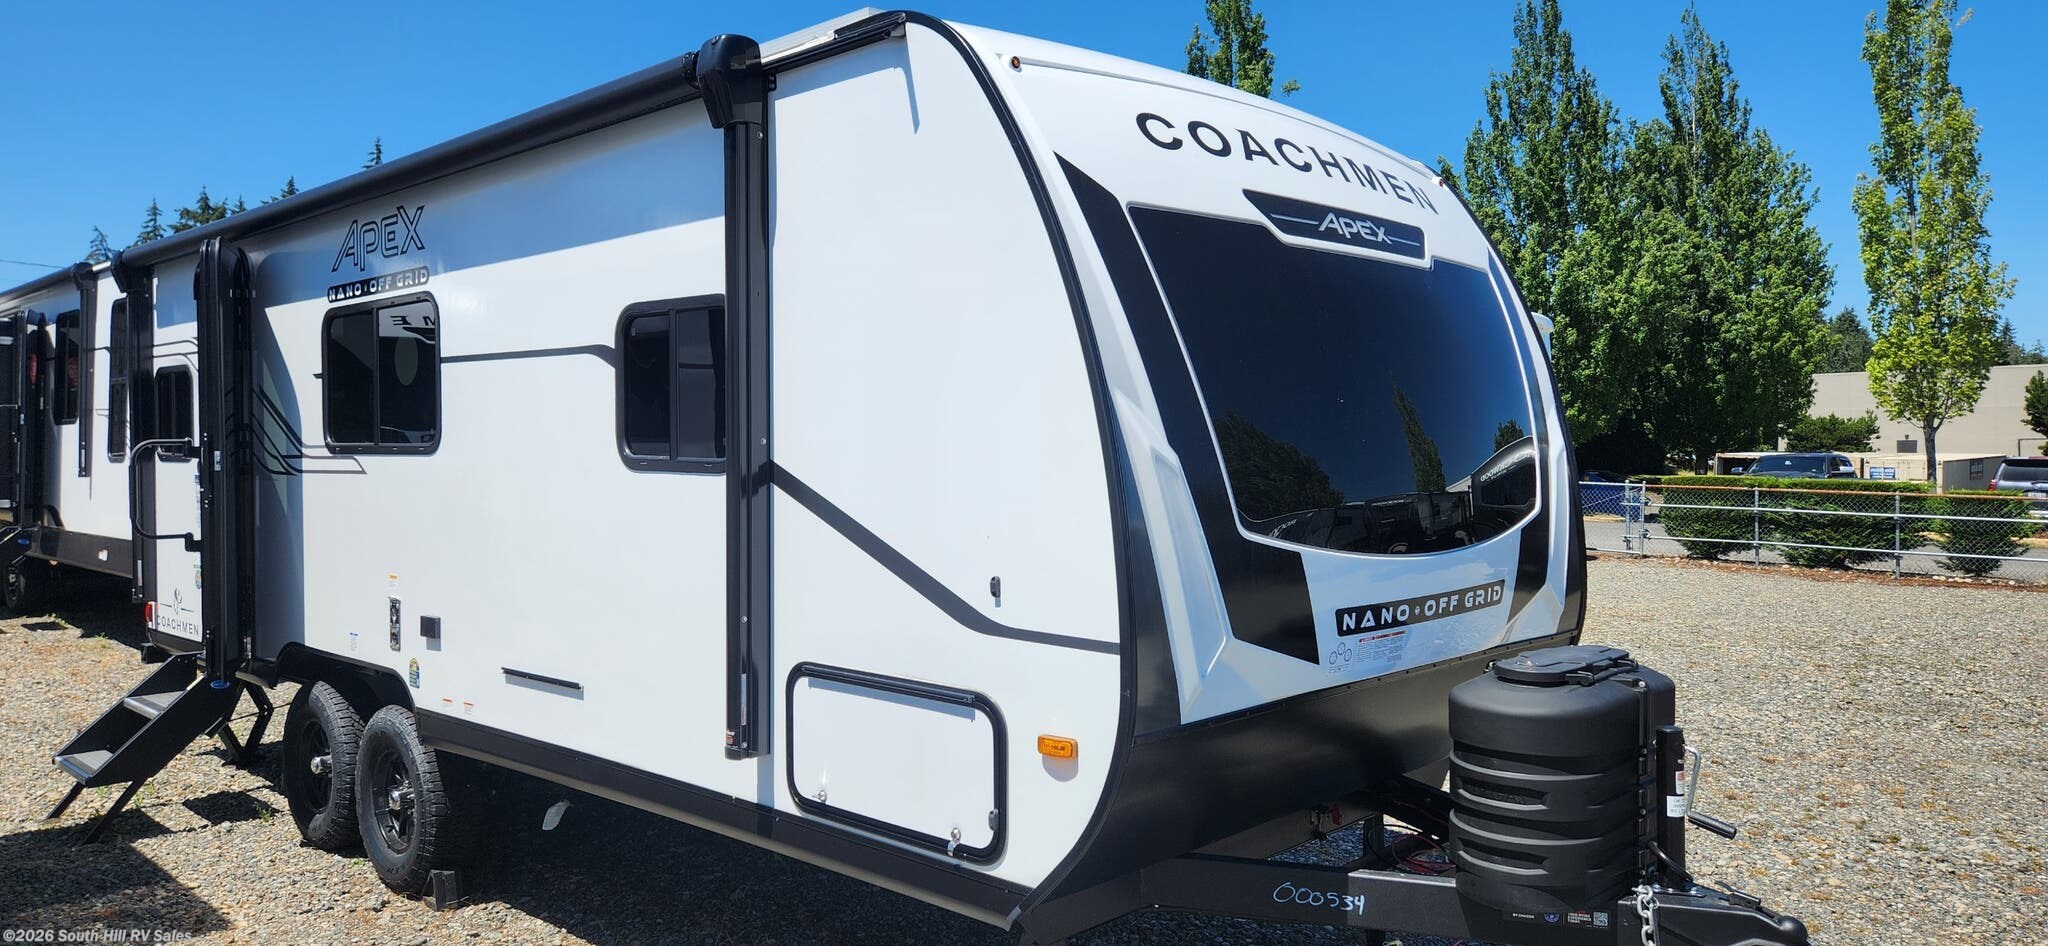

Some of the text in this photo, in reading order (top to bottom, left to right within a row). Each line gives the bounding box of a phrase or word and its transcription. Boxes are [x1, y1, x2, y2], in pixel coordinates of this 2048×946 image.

[1136, 112, 1439, 215] COACHMEN
[331, 205, 426, 272] APEX
[1318, 212, 1392, 244] APEX
[328, 269, 428, 301] NANO OFF GRID
[1342, 585, 1501, 631] NANO OFF GRID
[157, 614, 199, 636] COACHMEN
[1273, 882, 1365, 915] 000534
